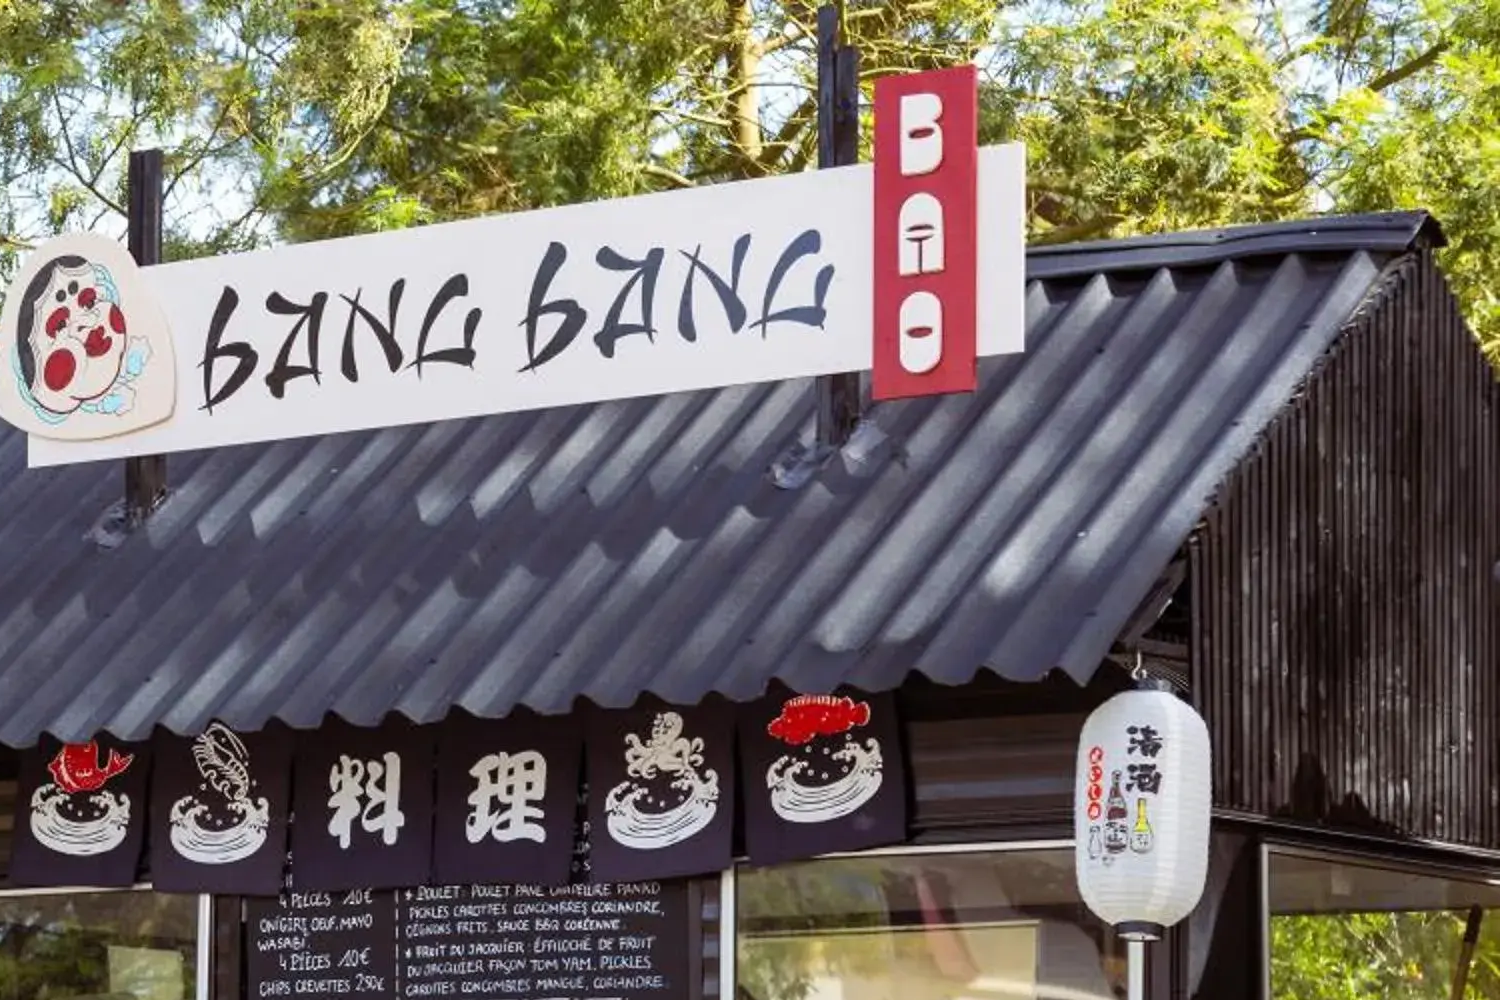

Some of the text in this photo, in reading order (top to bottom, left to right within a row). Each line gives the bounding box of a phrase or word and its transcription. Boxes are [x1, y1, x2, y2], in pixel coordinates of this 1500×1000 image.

[899, 93, 945, 374] BAO
[197, 228, 835, 416] BANG BANG
[295, 978, 351, 994] CREVETTES
[600, 954, 652, 970] PICKLES
